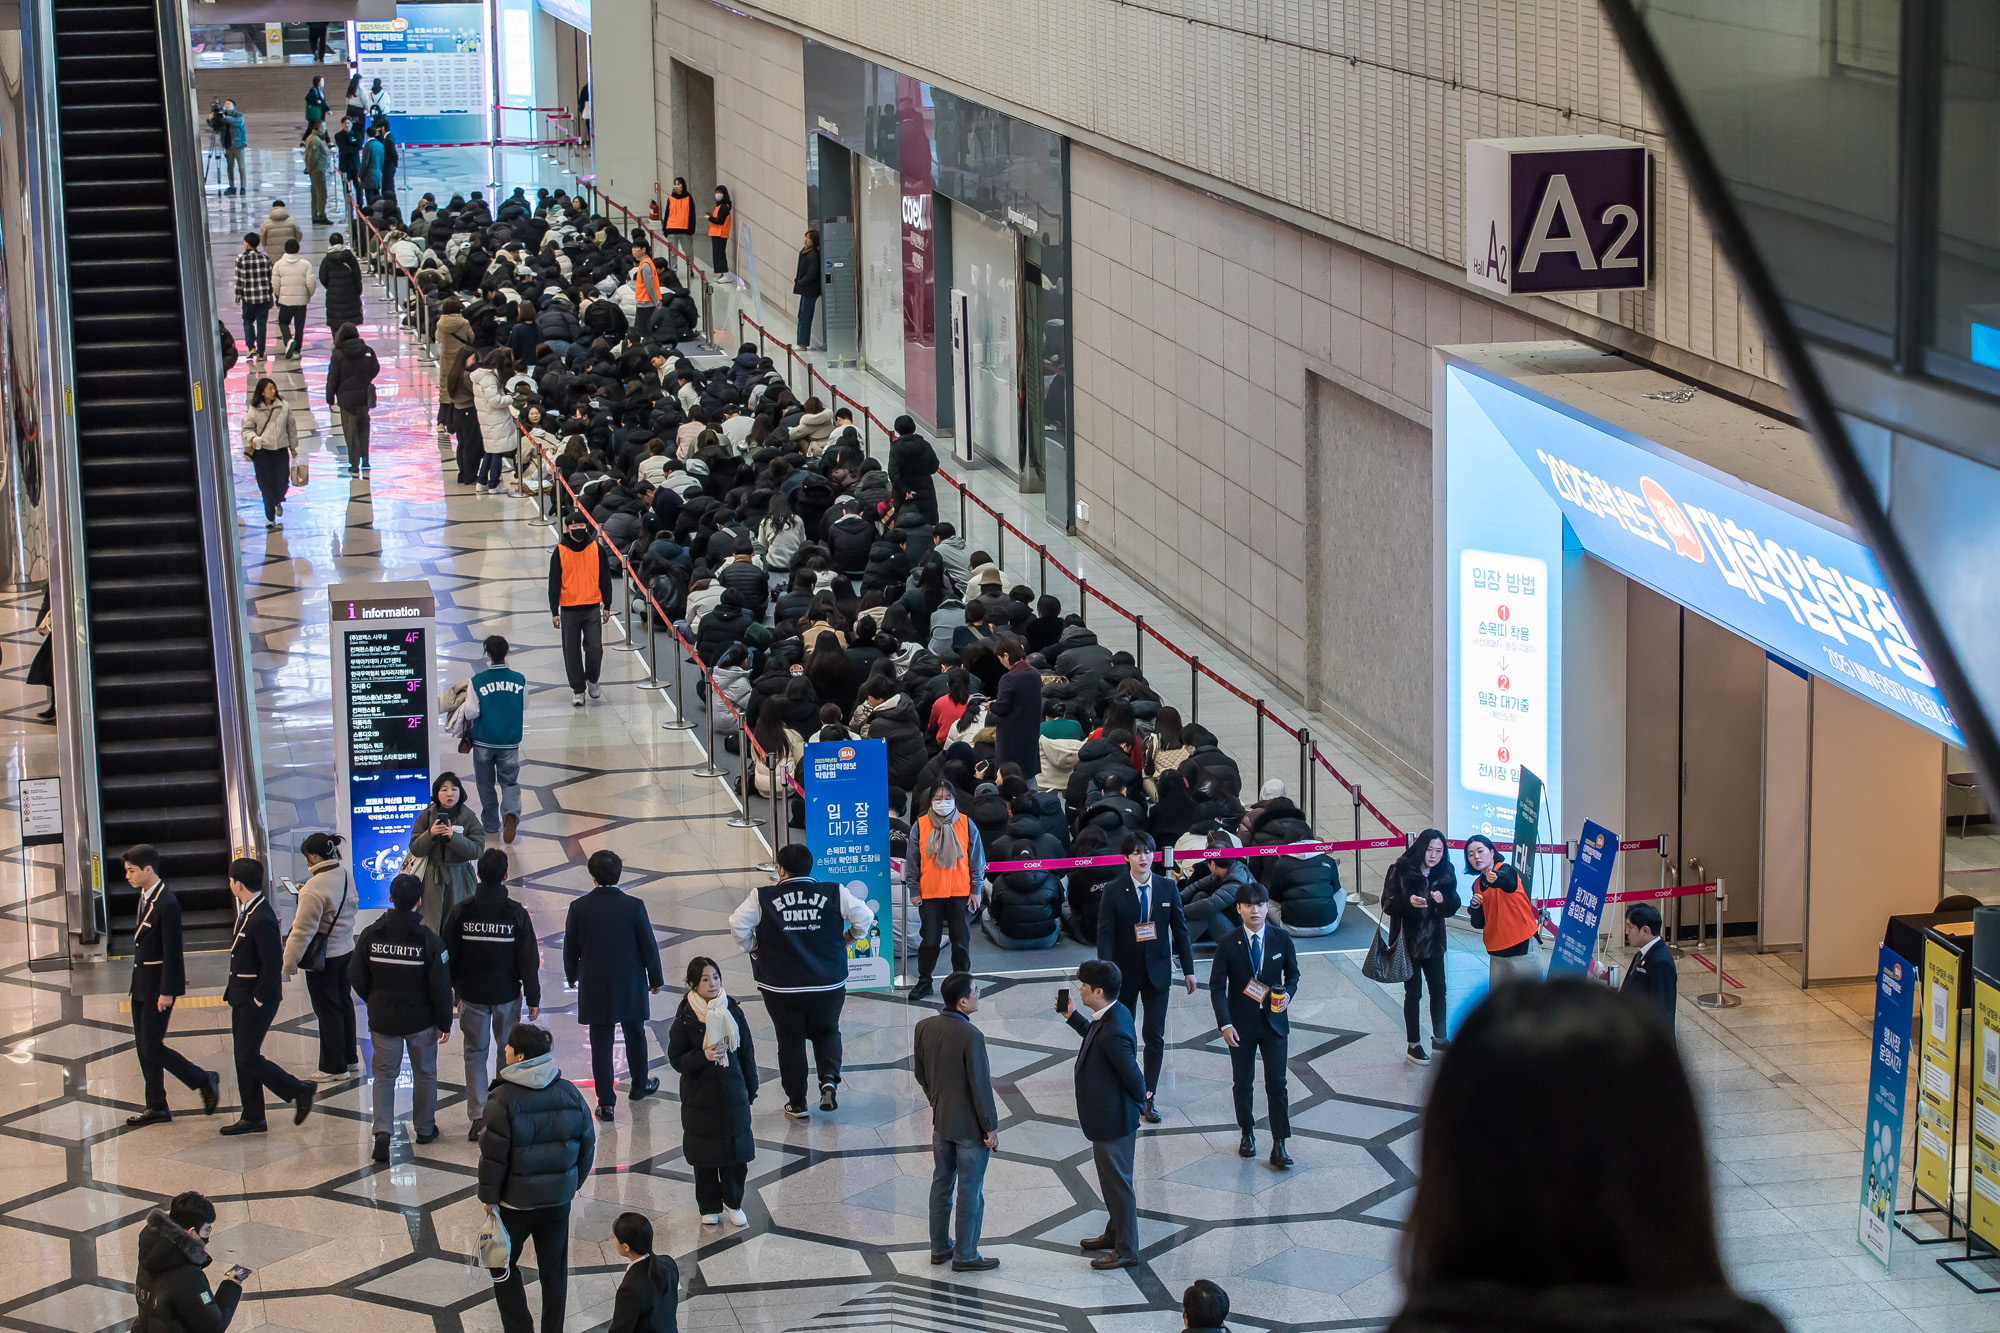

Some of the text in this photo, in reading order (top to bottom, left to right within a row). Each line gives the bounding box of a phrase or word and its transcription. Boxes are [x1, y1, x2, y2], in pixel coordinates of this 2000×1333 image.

[1518, 174, 1639, 273] A2
[1486, 220, 1507, 285] A2
[1536, 448, 1936, 688] 2025학년도 정시 대학입학정
[1472, 567, 1535, 597] 입장 방법
[362, 606, 420, 619] information
[405, 632, 420, 643] 4F
[1478, 621, 1530, 642] 손목띠 착용
[406, 680, 420, 692] 3F
[480, 681, 524, 696] SUNNY
[1848, 659, 1912, 706] UNIVERSITY
[1906, 687, 1959, 729] REGULA
[1478, 691, 1529, 713] 입장 대기줄
[408, 717, 422, 728] 2F
[814, 762, 856, 772] 대학입학정보
[1478, 762, 1520, 783] 전시장 입
[815, 771, 836, 779] 박람회
[828, 820, 868, 836] 대기줄
[1315, 843, 1334, 851] coex
[1371, 839, 1390, 847] coex
[1622, 842, 1640, 850] coex
[848, 845, 862, 854] 확인
[1204, 849, 1222, 858] coex
[1260, 846, 1278, 854] coex
[838, 855, 858, 864] 확인용
[860, 854, 880, 862] 도장을
[1024, 860, 1042, 868] coex
[1074, 858, 1093, 866] coex
[828, 864, 870, 874] 찍어드립니다.
[1654, 889, 1672, 898] coex
[1705, 884, 1717, 892] coe
[772, 891, 828, 912] EULJI
[1576, 886, 1598, 911] 참가대학
[782, 908, 822, 922] UNIV.
[1568, 901, 1586, 922] 출입증
[463, 922, 514, 934] SECURITY
[371, 943, 422, 956] SECURITY
[1884, 1026, 1900, 1053] 행사장
[1880, 1044, 1902, 1074] 운영시간
